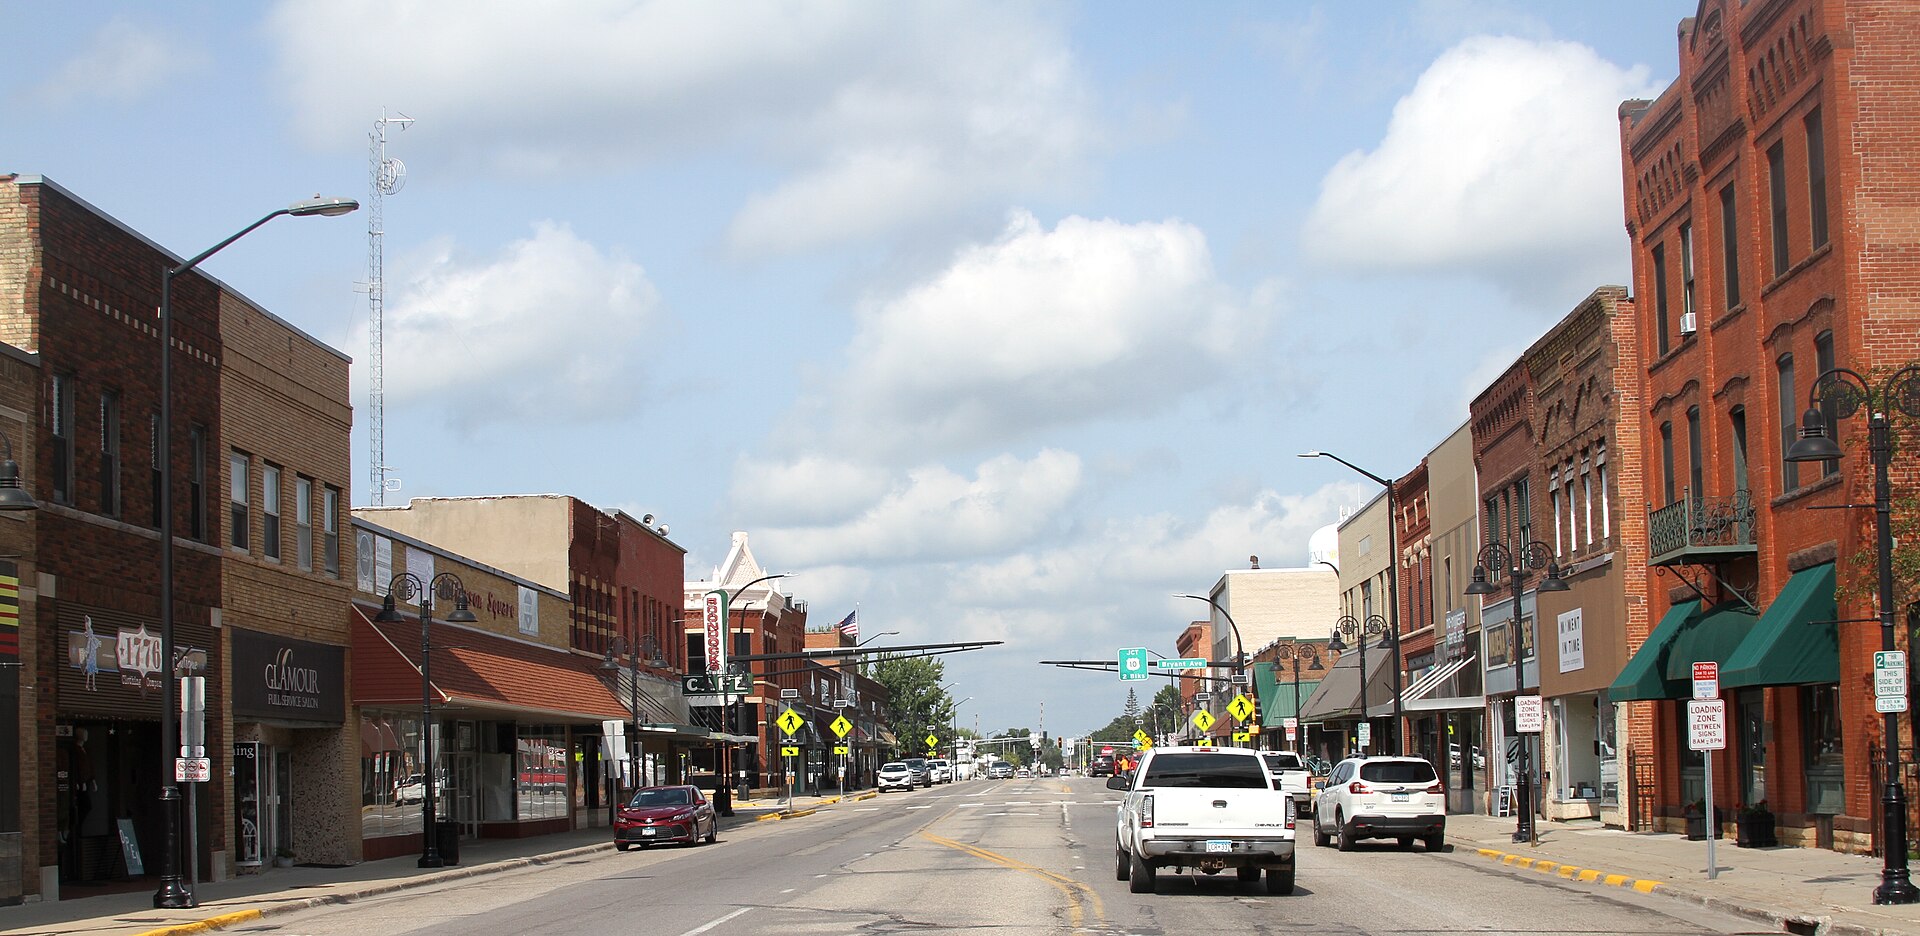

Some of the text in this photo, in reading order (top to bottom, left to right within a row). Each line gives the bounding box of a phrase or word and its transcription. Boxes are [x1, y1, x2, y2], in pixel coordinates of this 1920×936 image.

[487, 592, 515, 620] Square
[707, 598, 719, 671] BOONDOCKS
[1560, 616, 1580, 634] MMENT
[126, 637, 161, 669] 1776
[1562, 638, 1580, 654] IN TIME
[1876, 656, 1884, 666] 2
[265, 664, 320, 694] GLAMOUR
[268, 694, 318, 708] FULL SERVICE SALON
